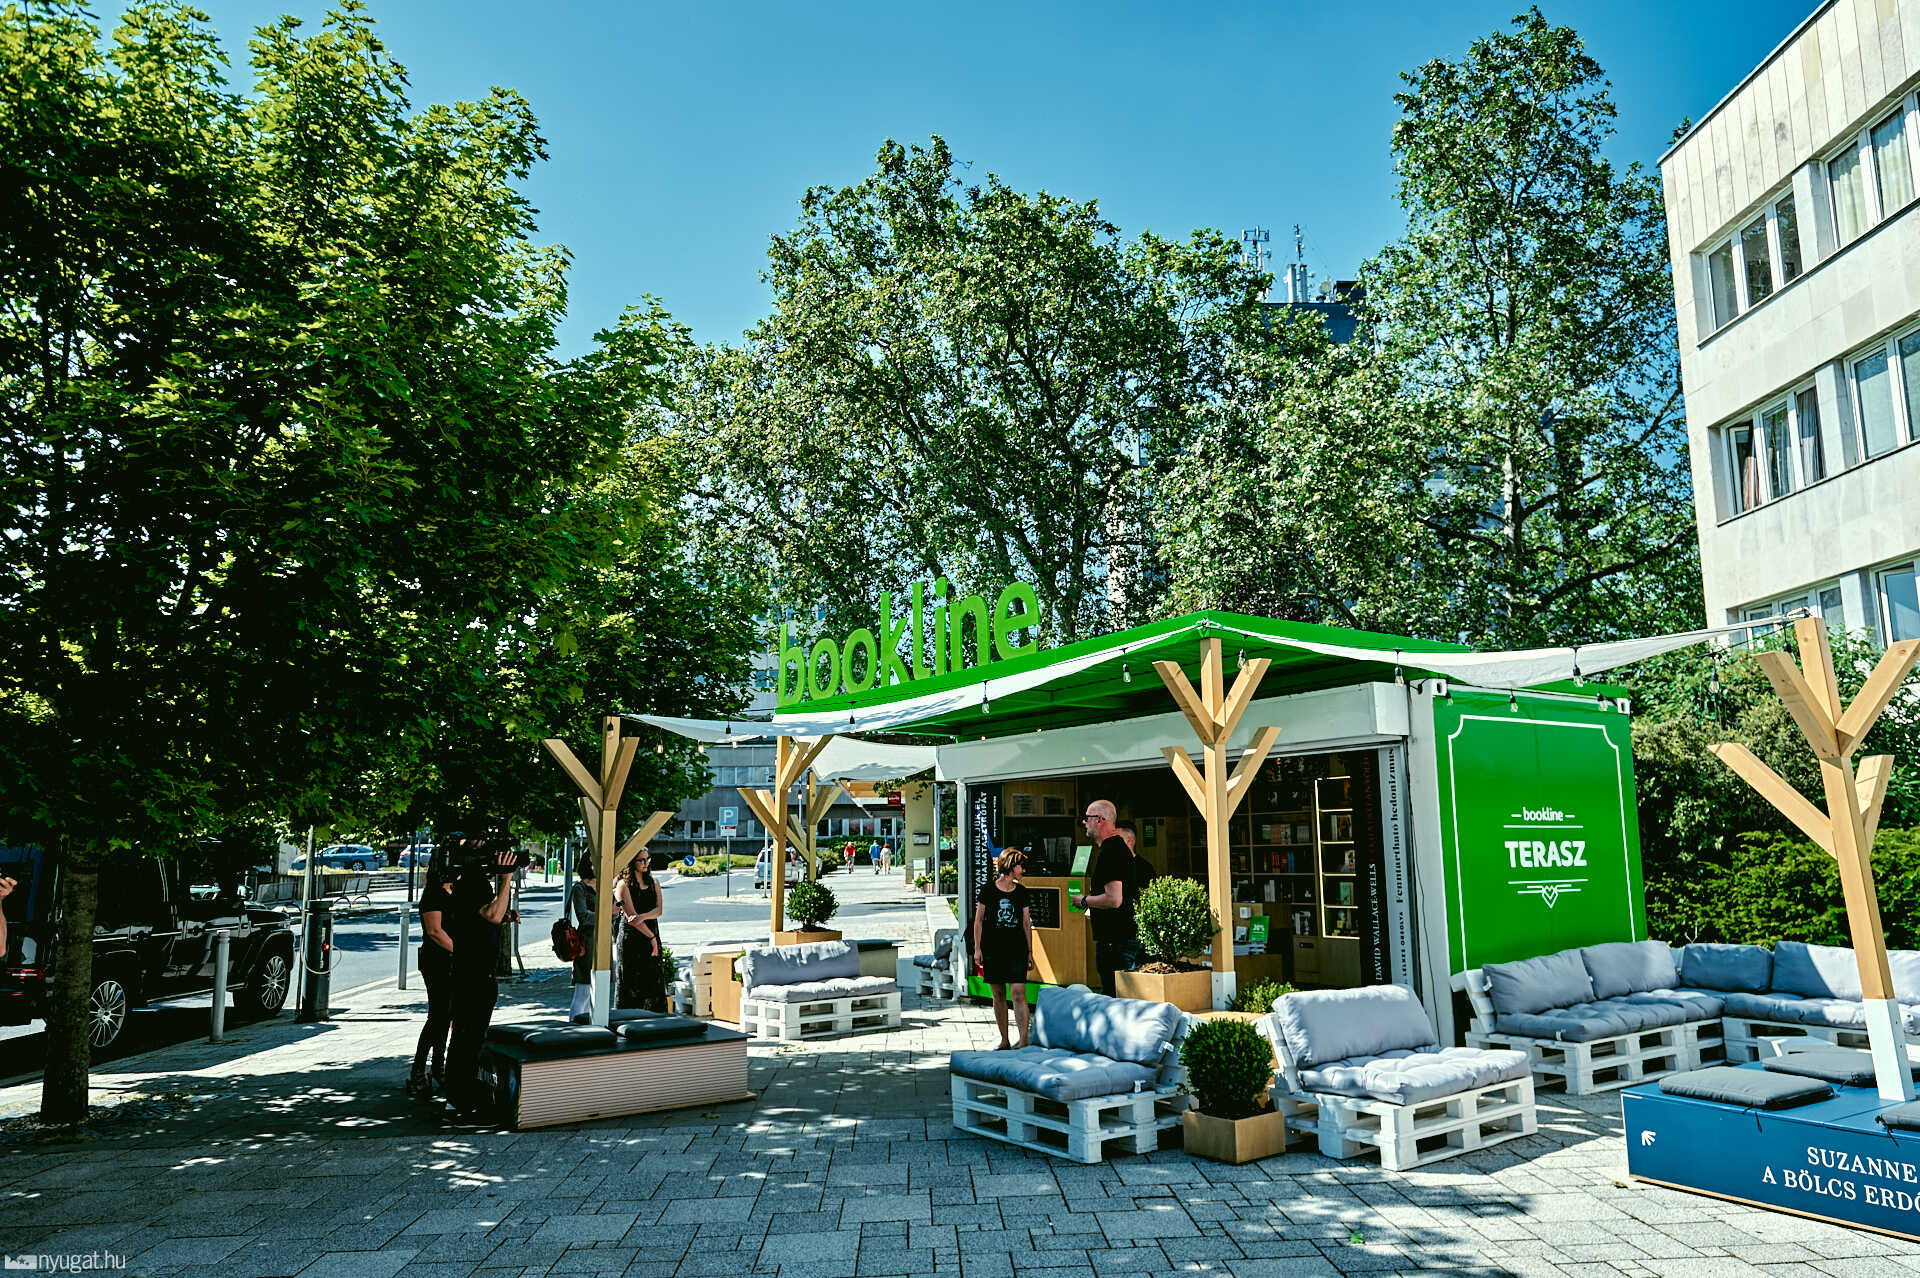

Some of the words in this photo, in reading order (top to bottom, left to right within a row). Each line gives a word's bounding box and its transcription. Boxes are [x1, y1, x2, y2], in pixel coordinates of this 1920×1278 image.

[778, 577, 1040, 707] bookline
[724, 809, 734, 824] P
[1522, 806, 1564, 822] bookline
[1504, 840, 1588, 868] TERASZ
[1374, 948, 1383, 981] DAVID
[1807, 1146, 1918, 1184] SUZANNE
[1762, 1165, 1777, 1185] A
[1783, 1169, 1857, 1201] BÖLCS
